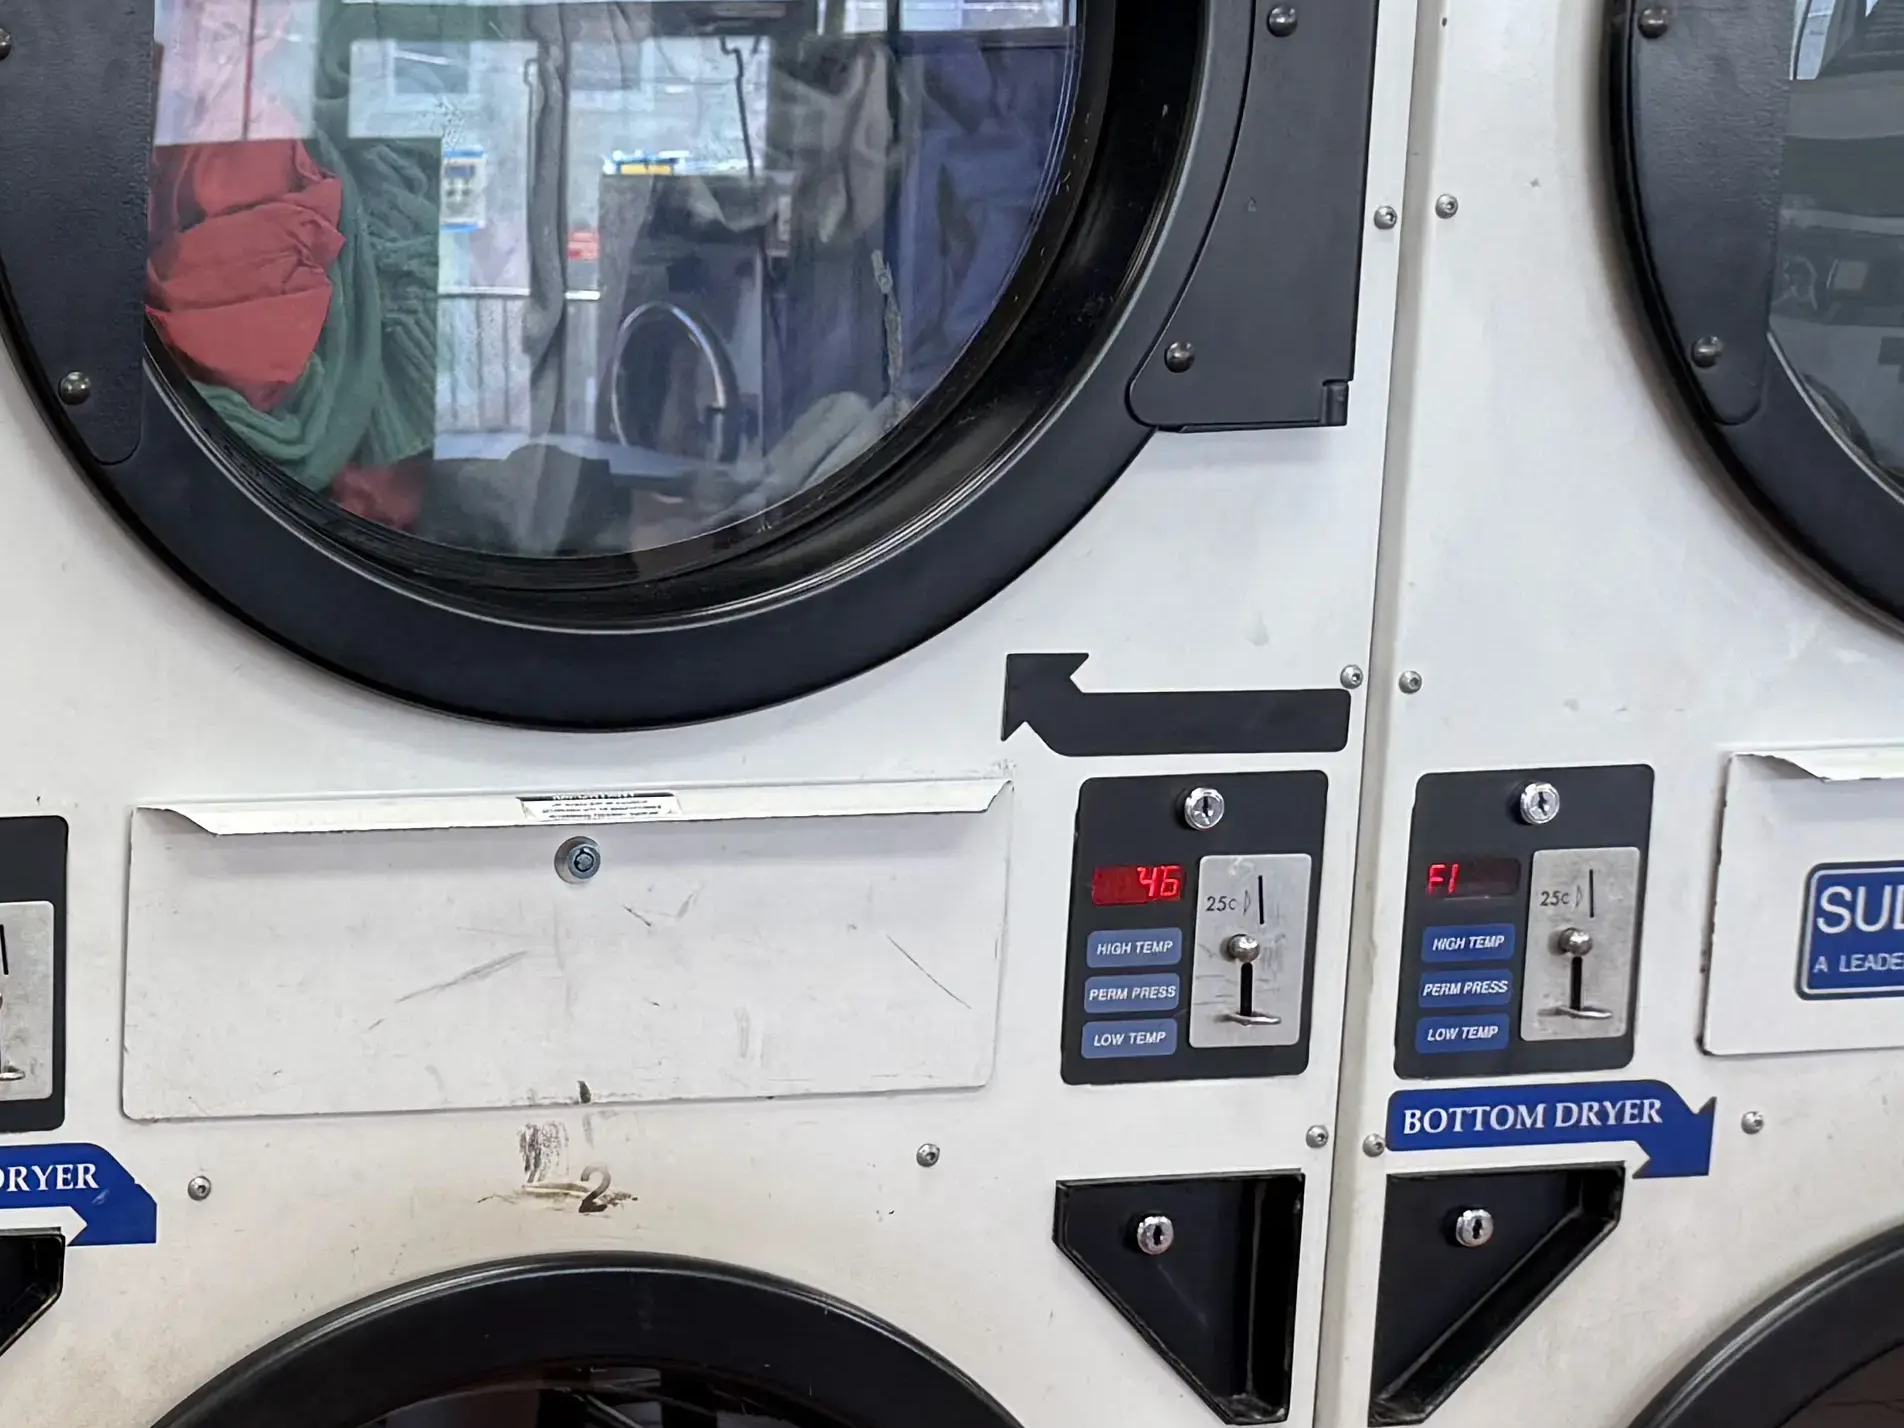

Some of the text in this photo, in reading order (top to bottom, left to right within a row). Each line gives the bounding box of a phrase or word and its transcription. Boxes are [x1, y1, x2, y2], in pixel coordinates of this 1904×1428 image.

[1096, 940, 1174, 955] HIGH TEMP
[1432, 934, 1505, 951] HIGH TEMP
[1813, 955, 1828, 973] A
[1088, 985, 1177, 1001] PERM PRESS
[1422, 980, 1509, 997] PERM PRESS
[1093, 1031, 1167, 1047] LOW TEMP
[1426, 1025, 1499, 1042] LOW TEMP
[1403, 1098, 1663, 1135] BOTTOM DRYER
